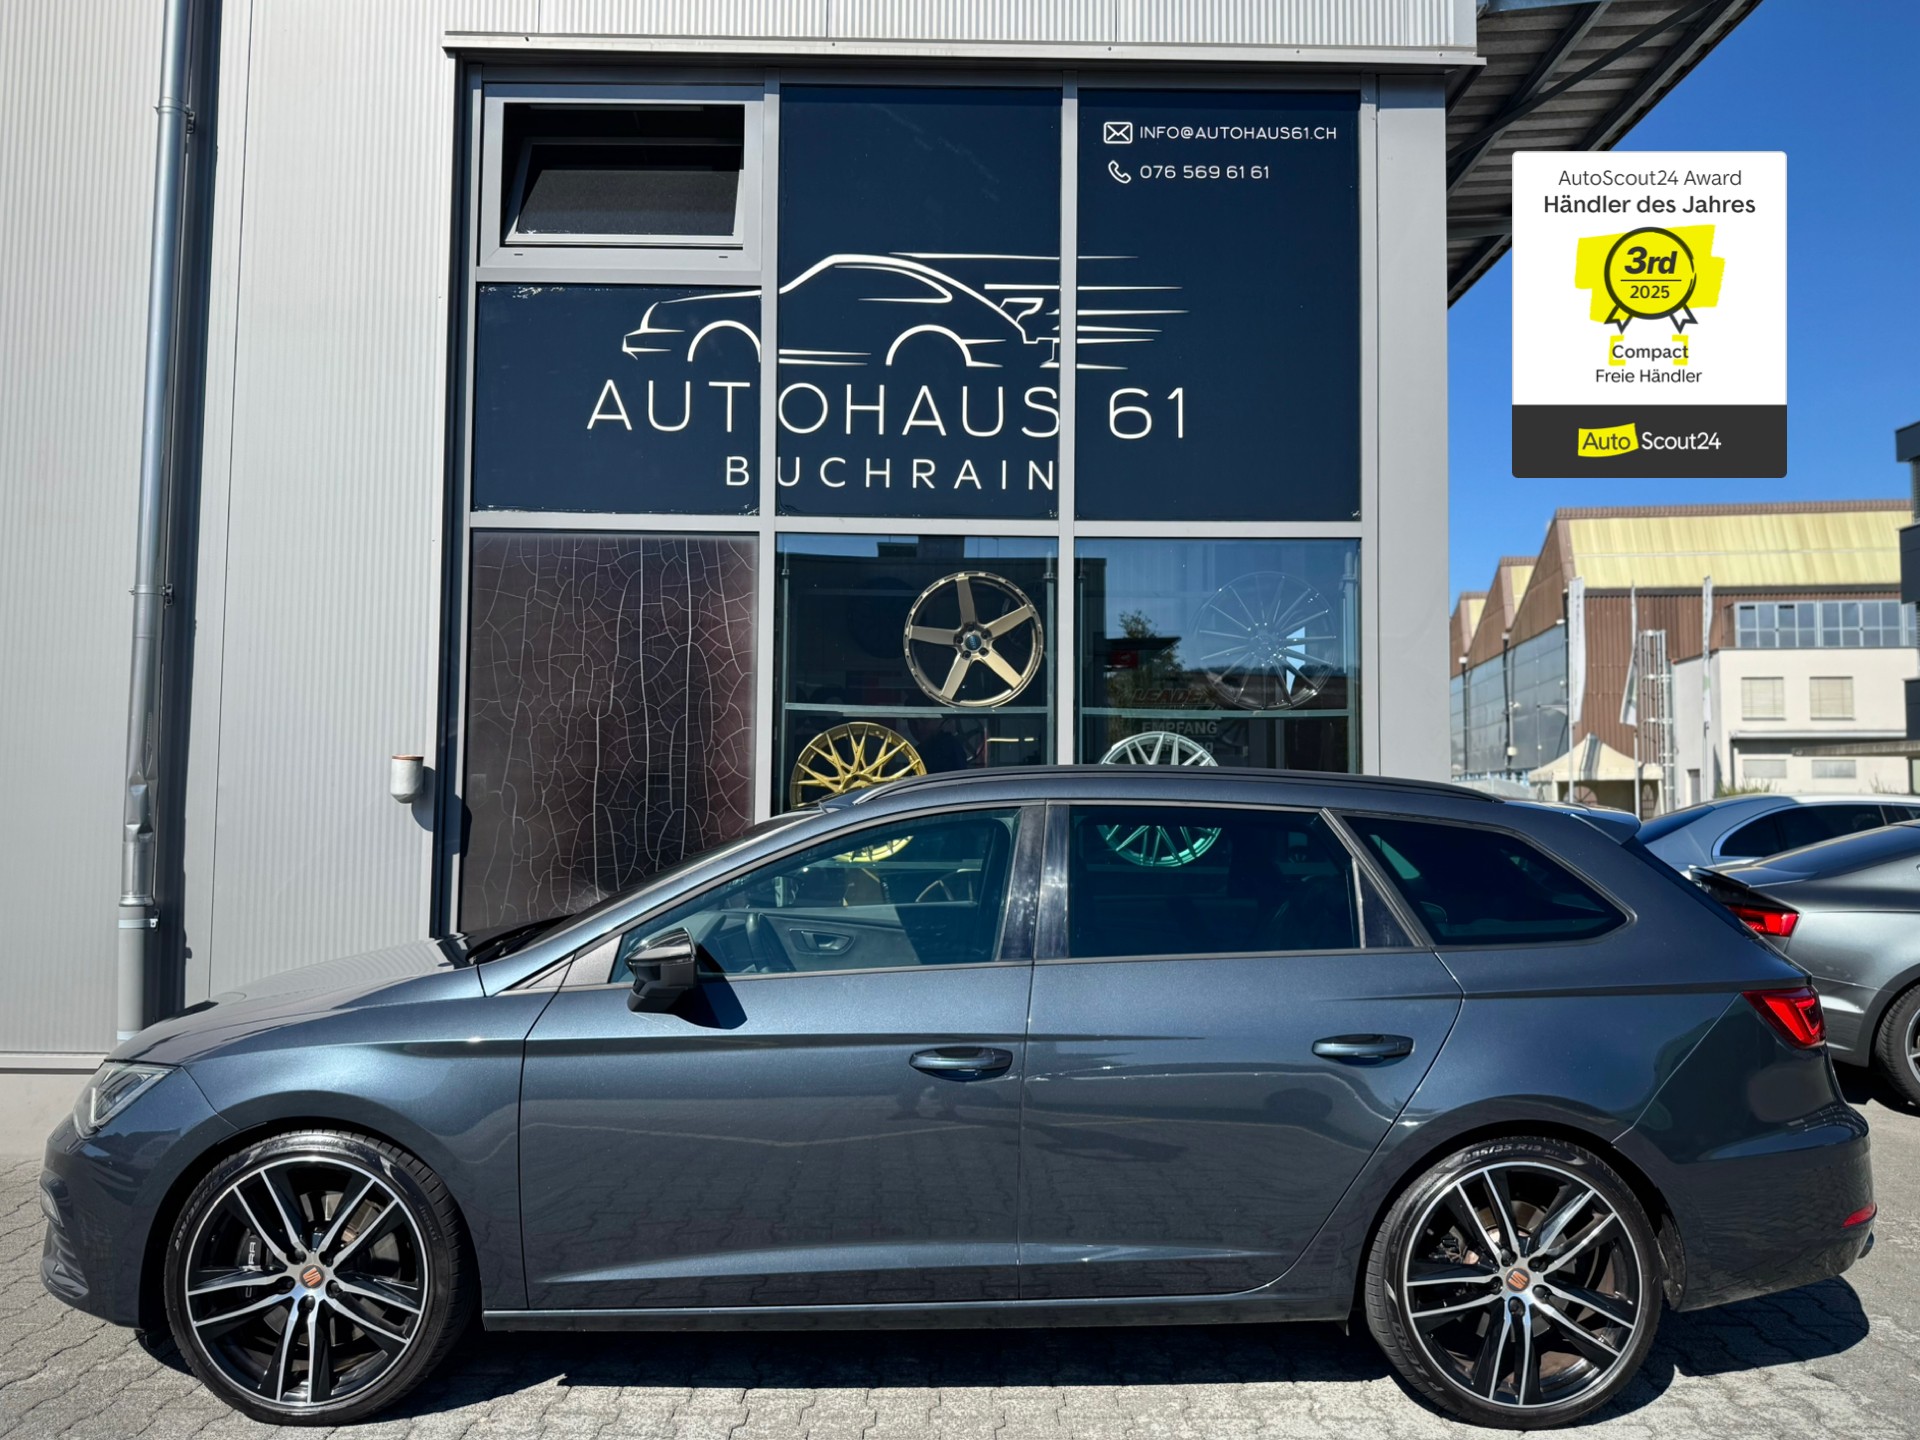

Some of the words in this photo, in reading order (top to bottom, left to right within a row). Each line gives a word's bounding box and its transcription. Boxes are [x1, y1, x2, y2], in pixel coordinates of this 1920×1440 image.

[1139, 126, 1337, 140] INFO@AUTOHAUS61.CH
[1139, 165, 1177, 179] 076
[1183, 165, 1221, 179] 569
[1226, 165, 1246, 179] 61
[1250, 165, 1270, 179] 61
[586, 379, 1060, 438] AUTOHAUS
[1109, 387, 1184, 439] 61
[725, 456, 1054, 490] BUCHRAIN
[1142, 721, 1217, 734] EMPFANG
